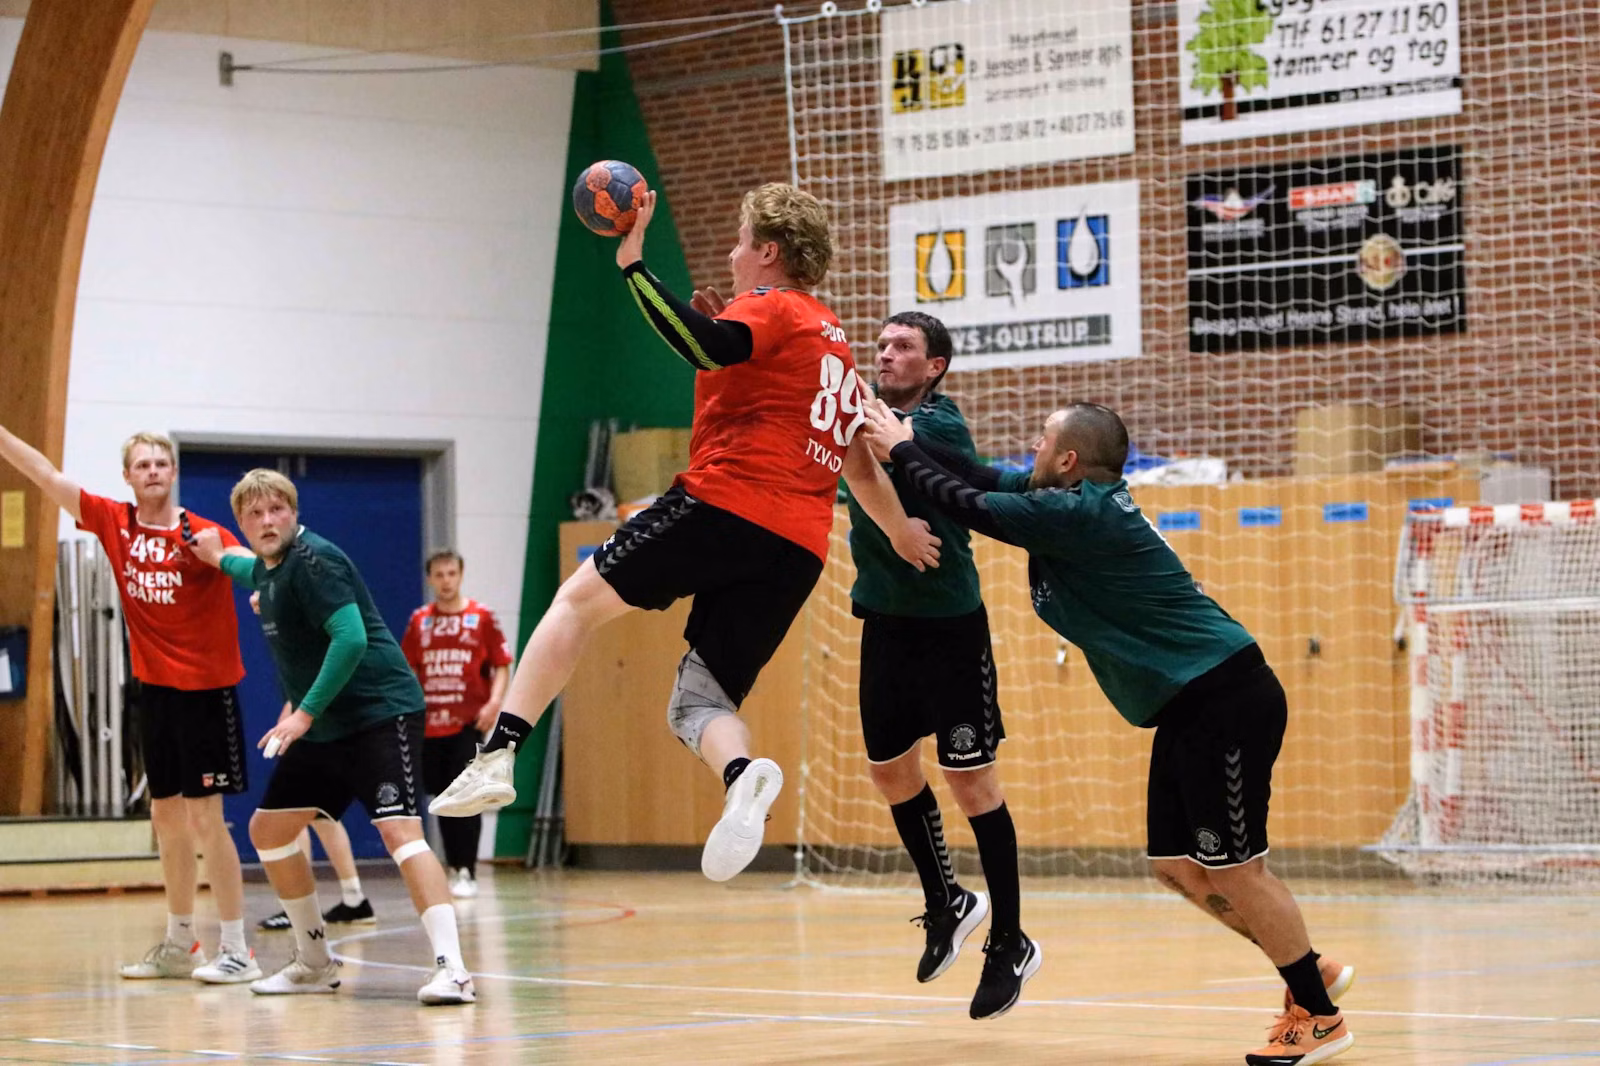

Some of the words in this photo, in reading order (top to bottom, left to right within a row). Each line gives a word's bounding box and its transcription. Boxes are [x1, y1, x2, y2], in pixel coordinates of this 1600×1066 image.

[1321, 16, 1345, 44] 61
[1353, 10, 1383, 39] 27
[1390, 6, 1410, 35] 11
[1416, 2, 1447, 32] 50
[1367, 45, 1395, 72] og
[1407, 38, 1448, 67] tag
[809, 353, 865, 446] 89
[130, 533, 167, 563] 46
[127, 581, 177, 605] BANK
[433, 615, 461, 637] 23
